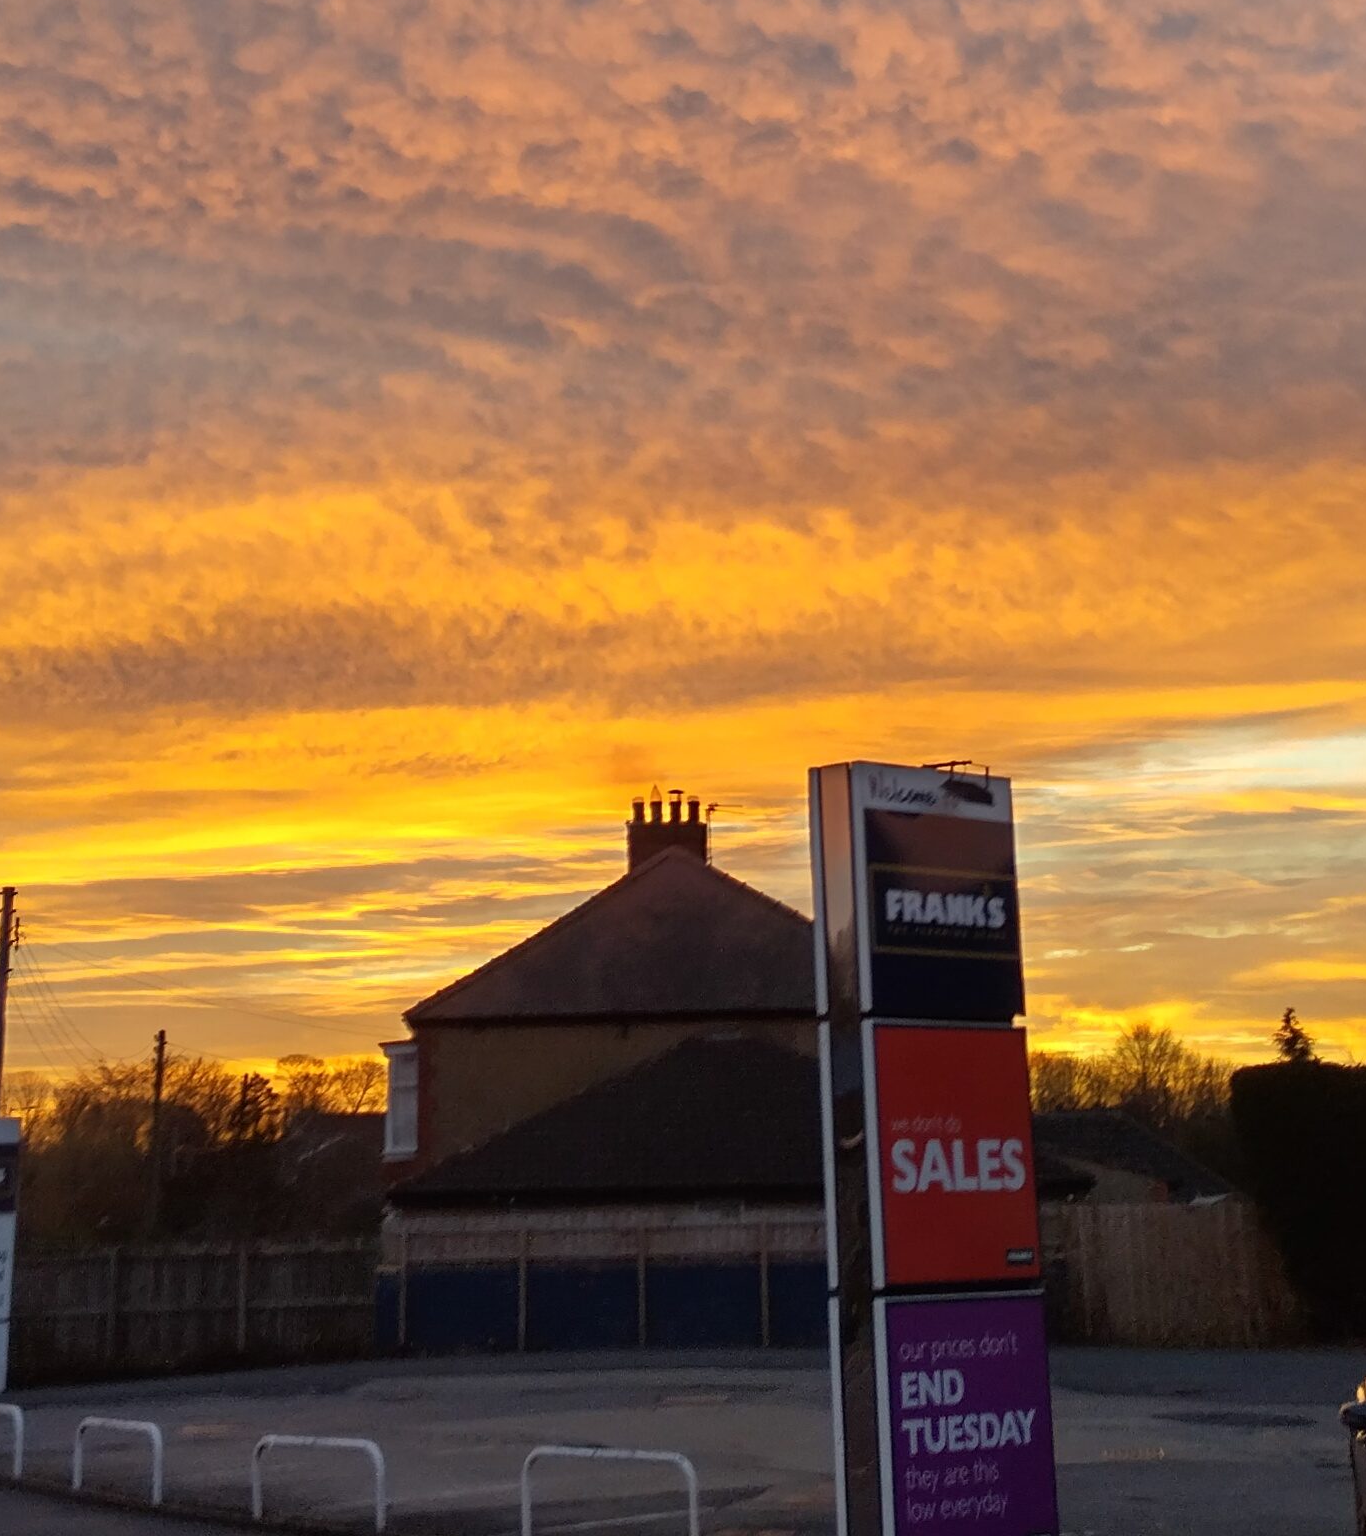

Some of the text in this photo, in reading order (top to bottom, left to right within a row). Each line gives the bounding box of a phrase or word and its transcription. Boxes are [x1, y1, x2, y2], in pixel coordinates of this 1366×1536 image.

[891, 1138, 1026, 1193] SALES
[899, 1331, 1018, 1363] our prices don't
[899, 1369, 965, 1409] END
[901, 1408, 1036, 1457] TUESDAY
[905, 1458, 1000, 1493] they are this
[906, 1497, 936, 1523] low
